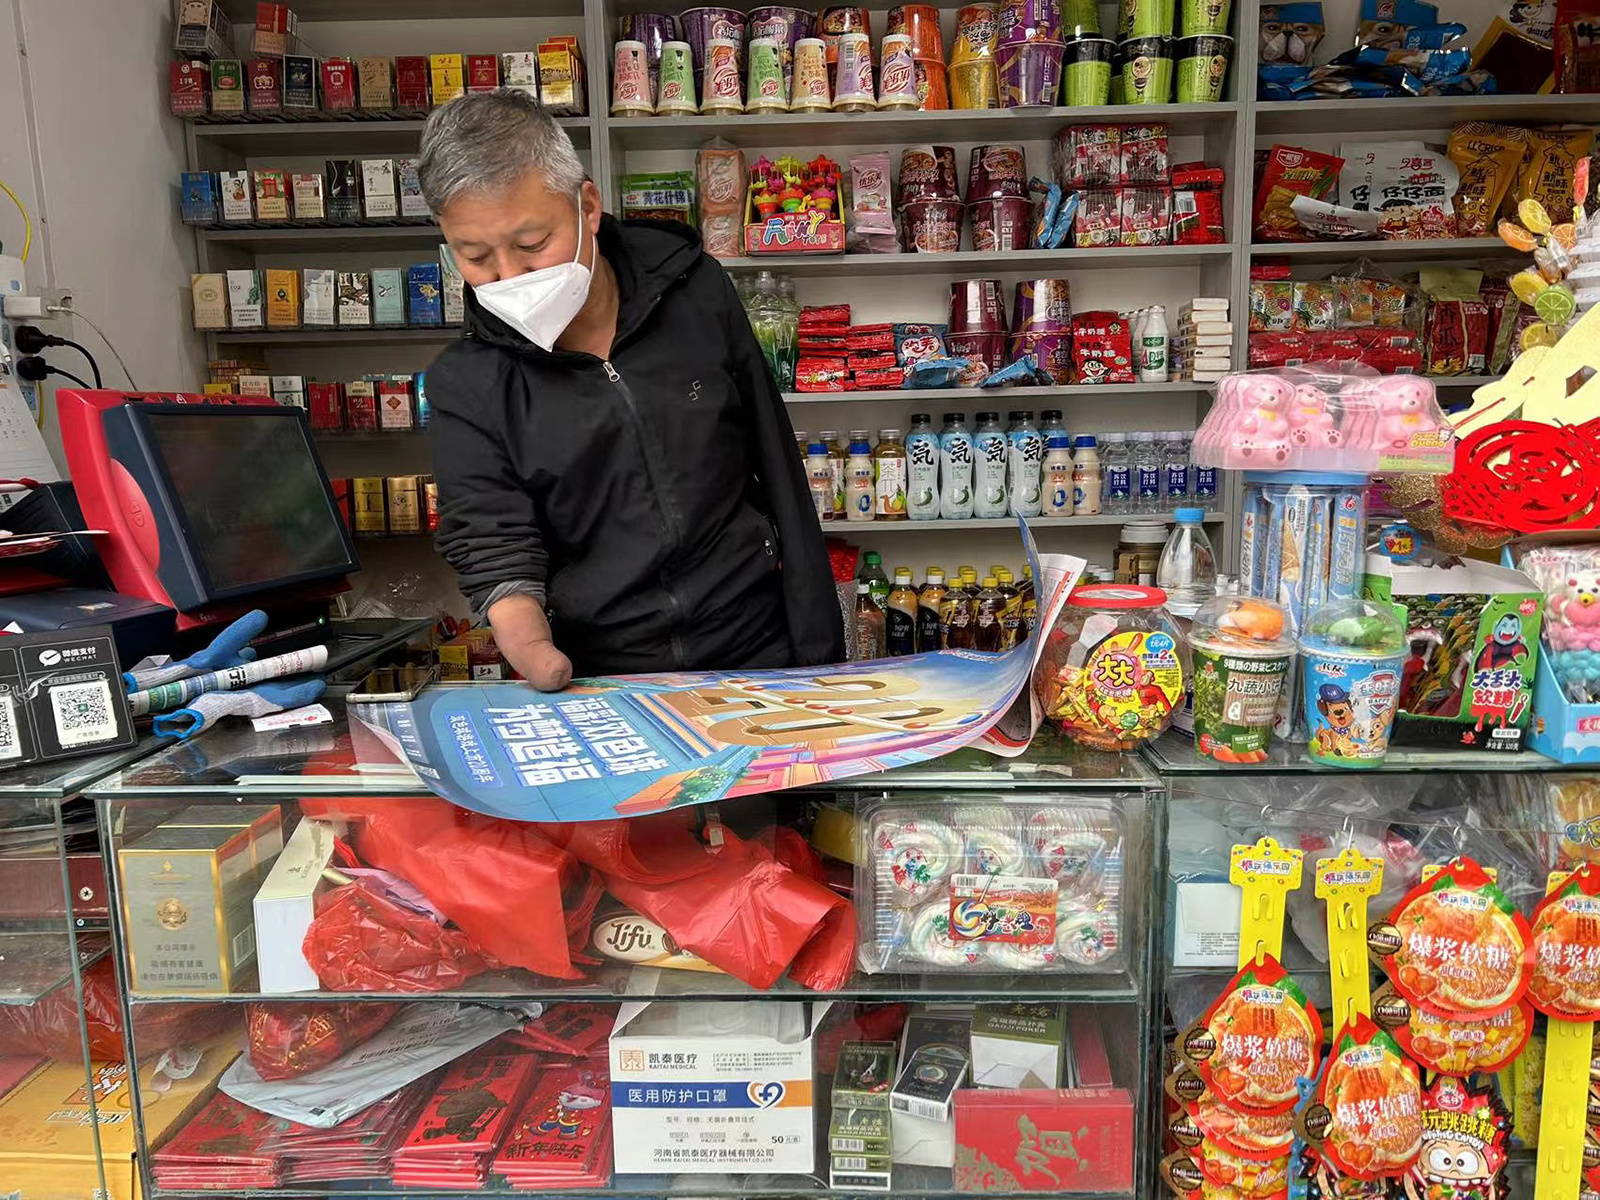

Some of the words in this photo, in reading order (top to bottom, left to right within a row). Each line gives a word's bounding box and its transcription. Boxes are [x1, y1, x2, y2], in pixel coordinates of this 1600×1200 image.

[1471, 670, 1522, 690] 大舌头
[1473, 689, 1515, 707] 软糖
[485, 703, 602, 787] 为梦造福
[557, 697, 669, 777] 福彩双色球
[1408, 933, 1511, 970] 爆浆软糖
[1221, 1034, 1303, 1061] 爆浆软糖
[648, 1053, 698, 1064] 凯泰医疗
[628, 1088, 728, 1104] 医用防护口罩
[1336, 1093, 1420, 1127] 爆浆软糖
[771, 1135, 784, 1144] 50
[503, 1140, 586, 1160] 新年快乐
[653, 1148, 775, 1158] 河南省凯泰医疗器械有限公司
